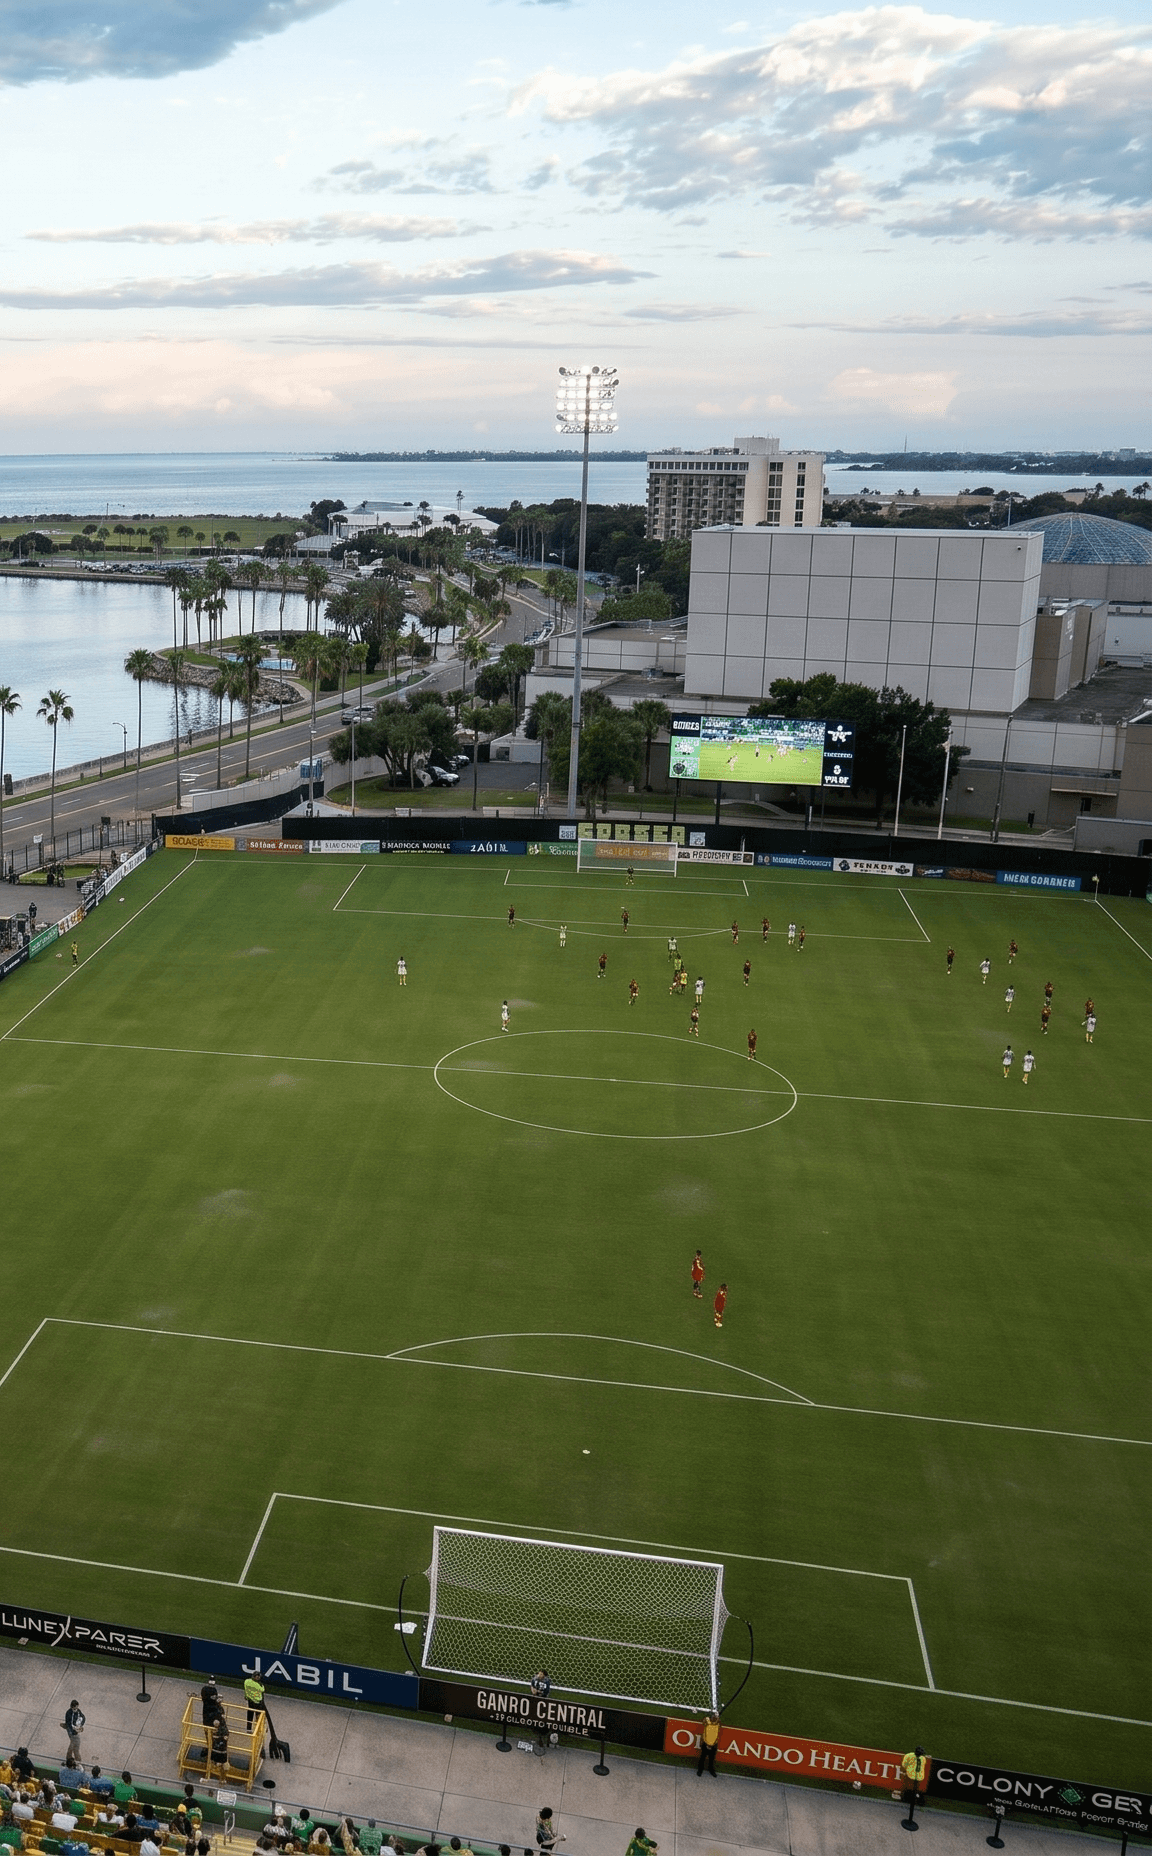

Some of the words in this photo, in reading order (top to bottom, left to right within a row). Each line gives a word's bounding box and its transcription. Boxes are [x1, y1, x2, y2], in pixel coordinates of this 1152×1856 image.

[241, 1656, 363, 1694] JABIL
[477, 1690, 530, 1717] GANRO
[536, 1700, 606, 1729] CENTRAL
[936, 1767, 1054, 1799] COLONY
